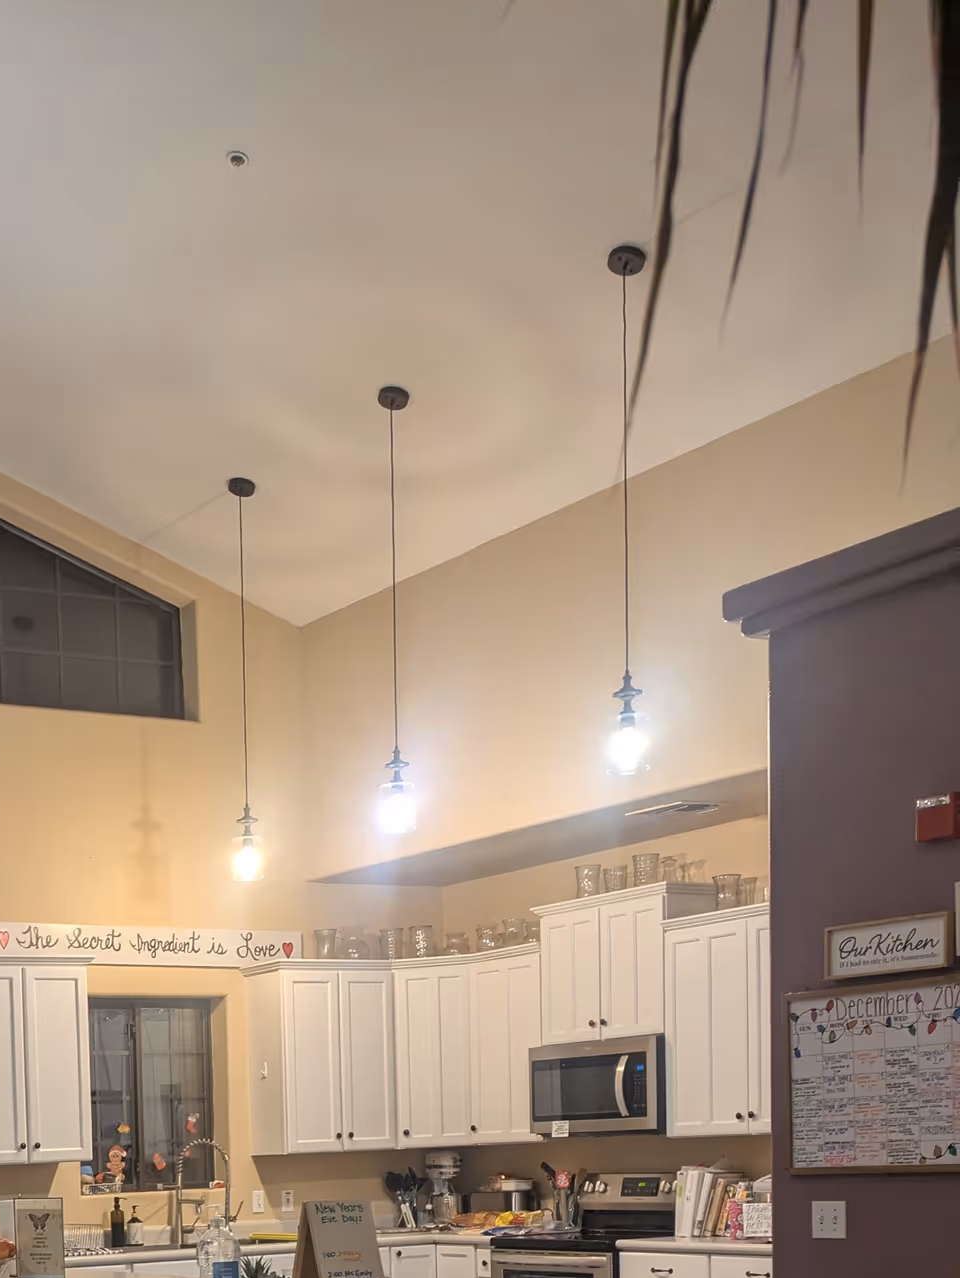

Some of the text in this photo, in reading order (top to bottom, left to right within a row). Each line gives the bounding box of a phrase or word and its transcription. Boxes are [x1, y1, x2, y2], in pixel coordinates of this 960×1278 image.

[15, 925, 280, 961] The Secret Ingredient is Love
[839, 928, 940, 959] Our Kitchen
[835, 992, 914, 1020] December
[315, 1202, 364, 1214] New Years
[321, 1215, 338, 1224] Eve
[355, 1270, 372, 1278] Emily
